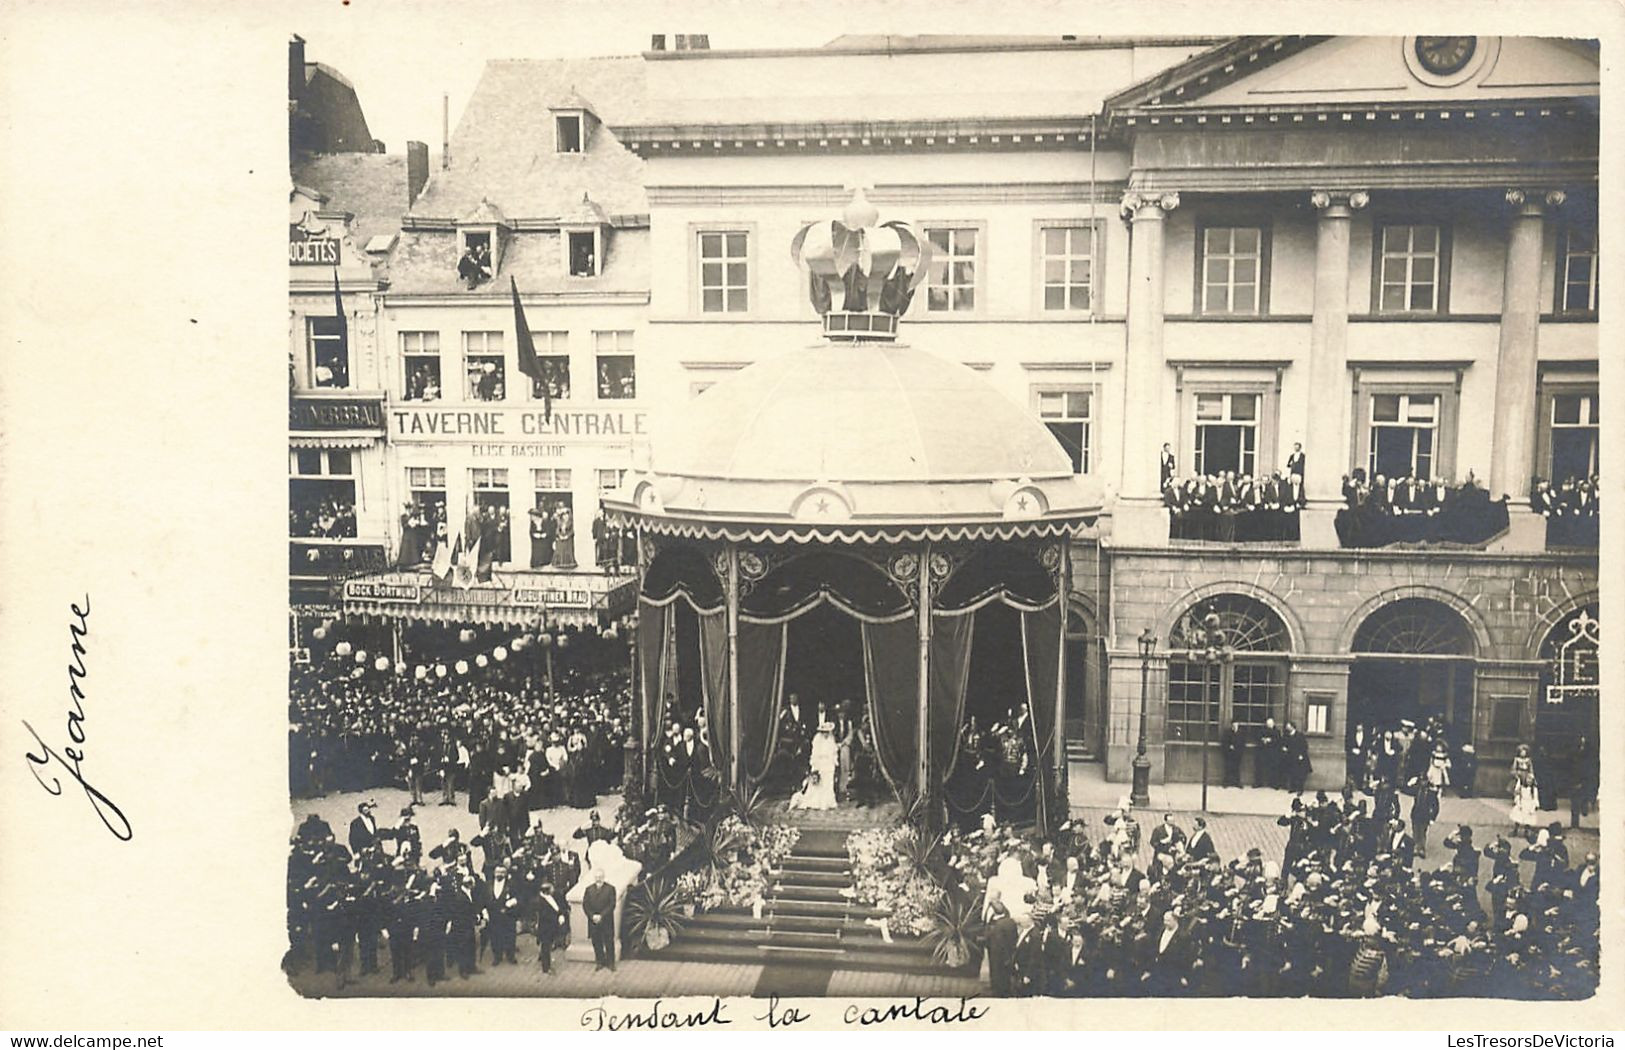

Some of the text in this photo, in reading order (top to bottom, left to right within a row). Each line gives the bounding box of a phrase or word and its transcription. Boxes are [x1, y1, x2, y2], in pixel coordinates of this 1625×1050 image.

[393, 412, 648, 434] TAVERNE CENTRALE
[472, 444, 566, 457] ELISE BASILIDE
[349, 583, 416, 599] BOCK DORTMUND
[21, 592, 133, 842] Jeanne
[580, 998, 733, 1031] Pendant
[753, 992, 811, 1028] la
